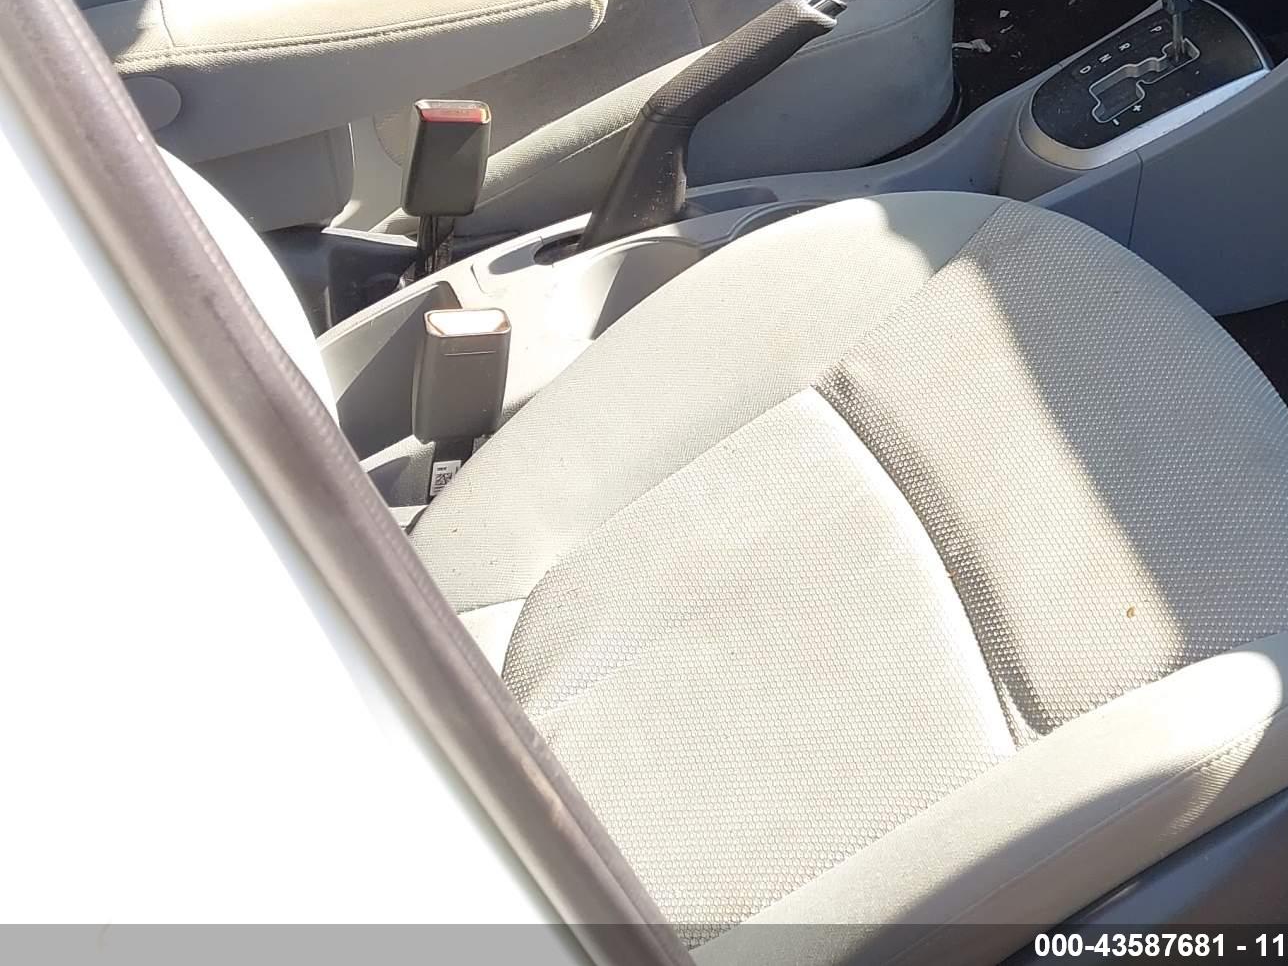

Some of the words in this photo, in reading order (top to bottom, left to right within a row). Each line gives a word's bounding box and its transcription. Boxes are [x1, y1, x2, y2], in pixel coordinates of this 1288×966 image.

[1150, 25, 1162, 33] P
[1119, 42, 1131, 51] R
[1099, 53, 1112, 63] N
[1079, 65, 1092, 74] D
